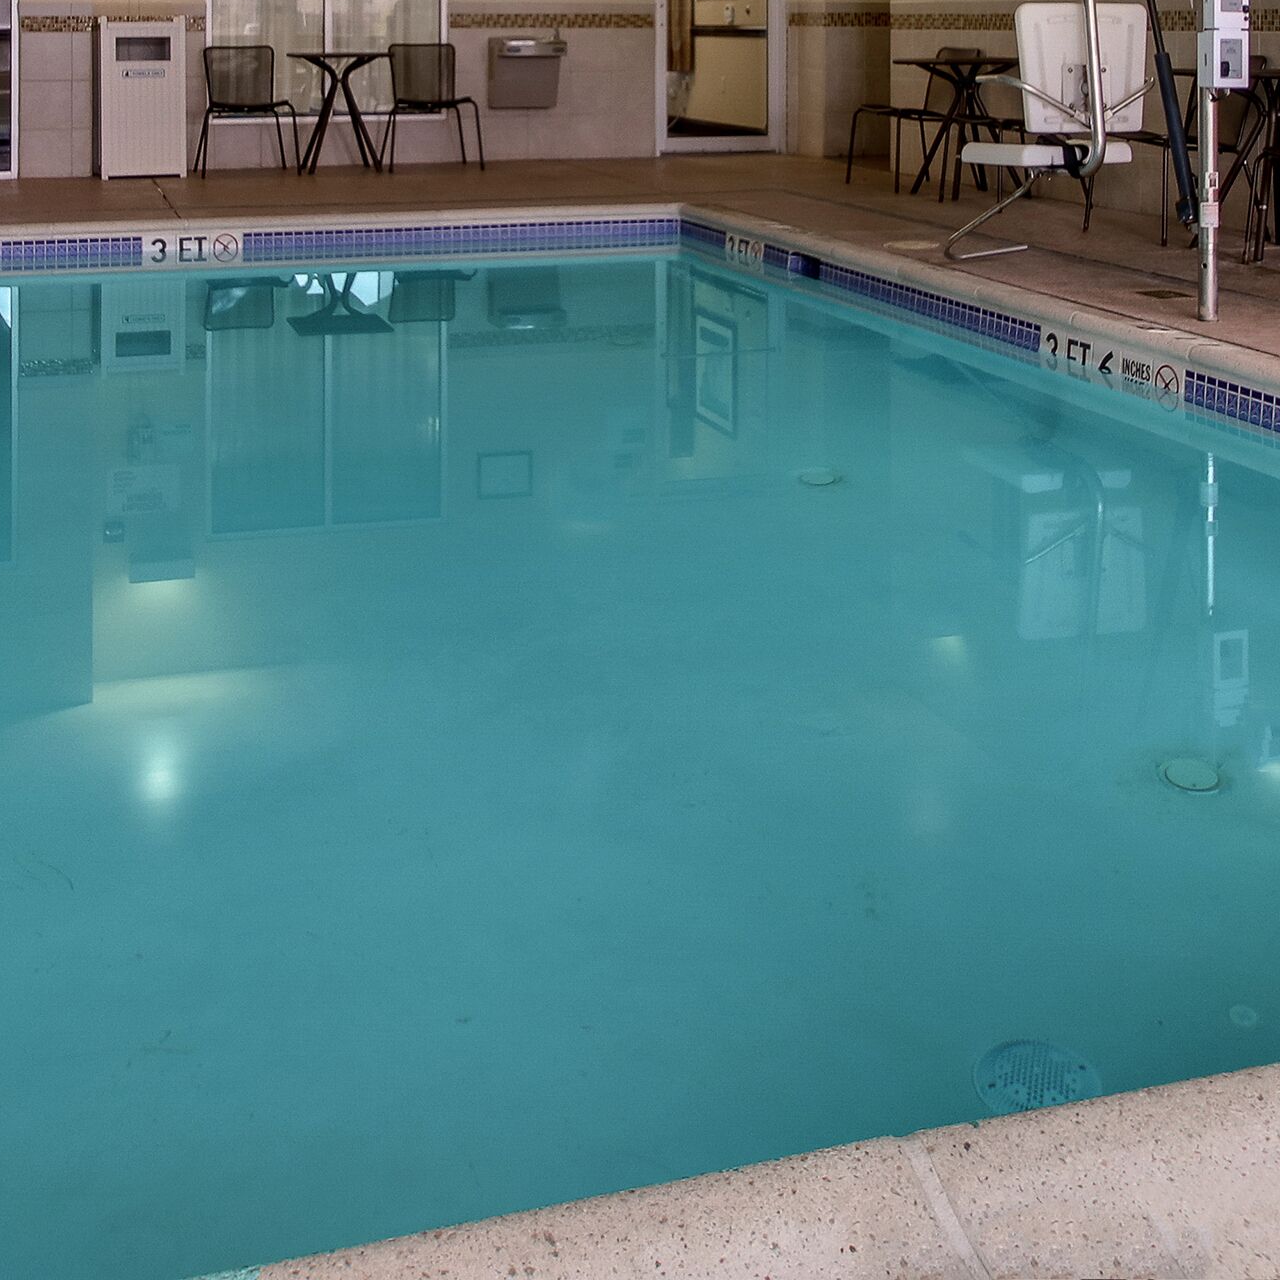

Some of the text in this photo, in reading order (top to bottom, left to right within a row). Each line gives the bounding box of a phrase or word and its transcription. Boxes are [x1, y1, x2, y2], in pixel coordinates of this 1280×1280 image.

[151, 238, 167, 262] 3
[1067, 338, 1091, 366] FT
[1099, 350, 1114, 375] 6
[1122, 357, 1151, 382] INCHES
